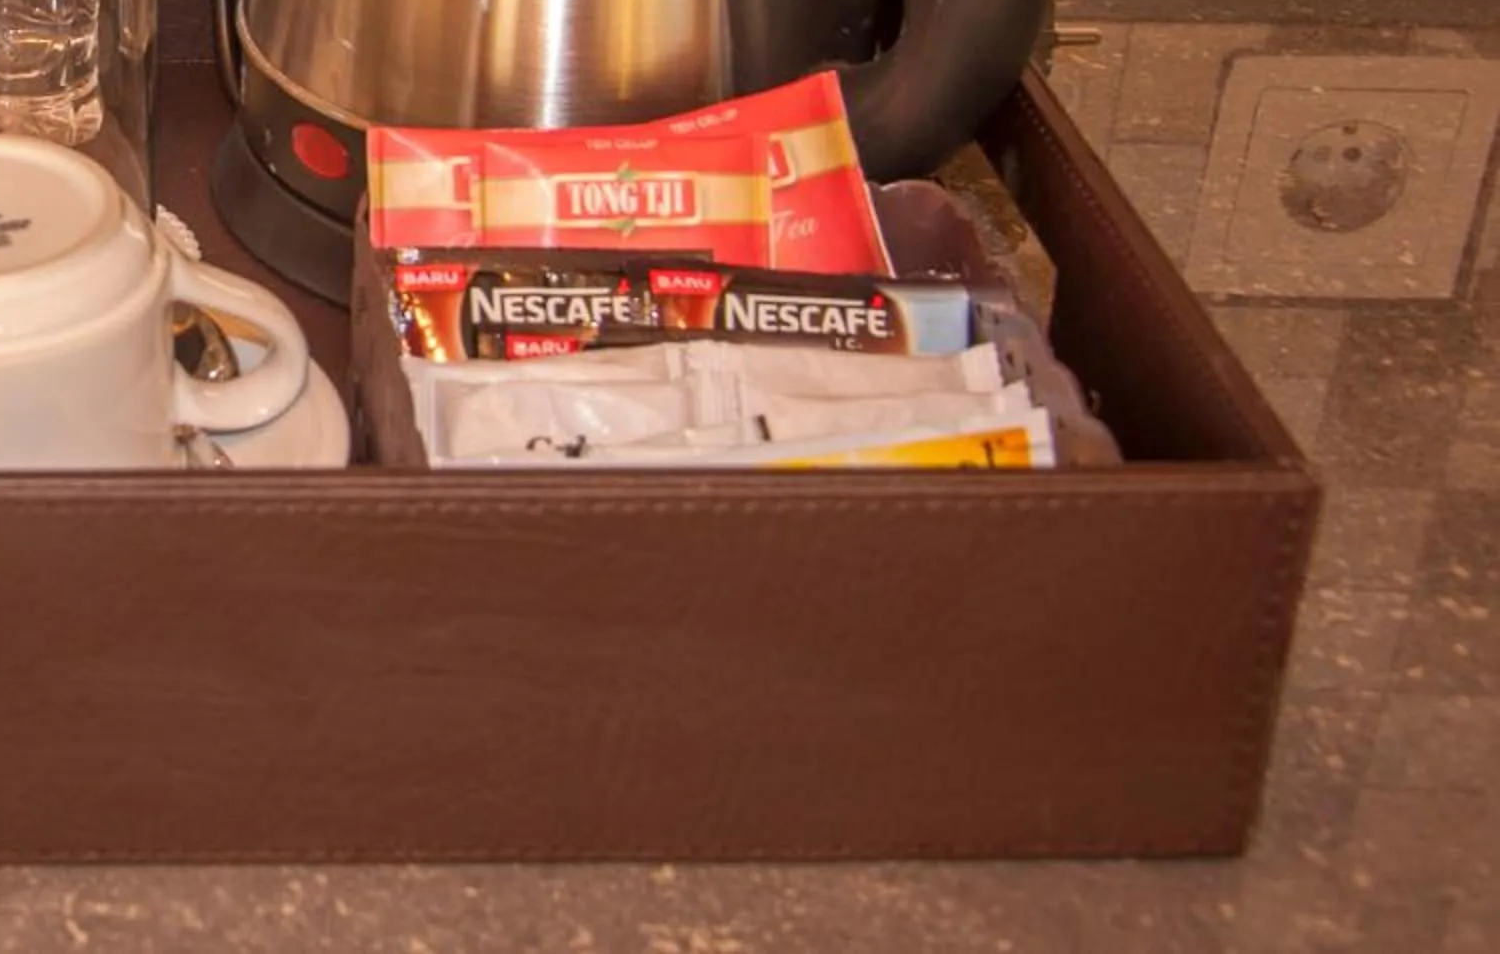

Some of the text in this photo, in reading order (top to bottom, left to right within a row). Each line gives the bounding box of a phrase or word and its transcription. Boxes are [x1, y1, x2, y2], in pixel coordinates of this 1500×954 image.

[566, 181, 685, 218] TONG TJI
[402, 271, 459, 285] BARU
[657, 275, 713, 290] BARU
[513, 340, 571, 356] BARU
